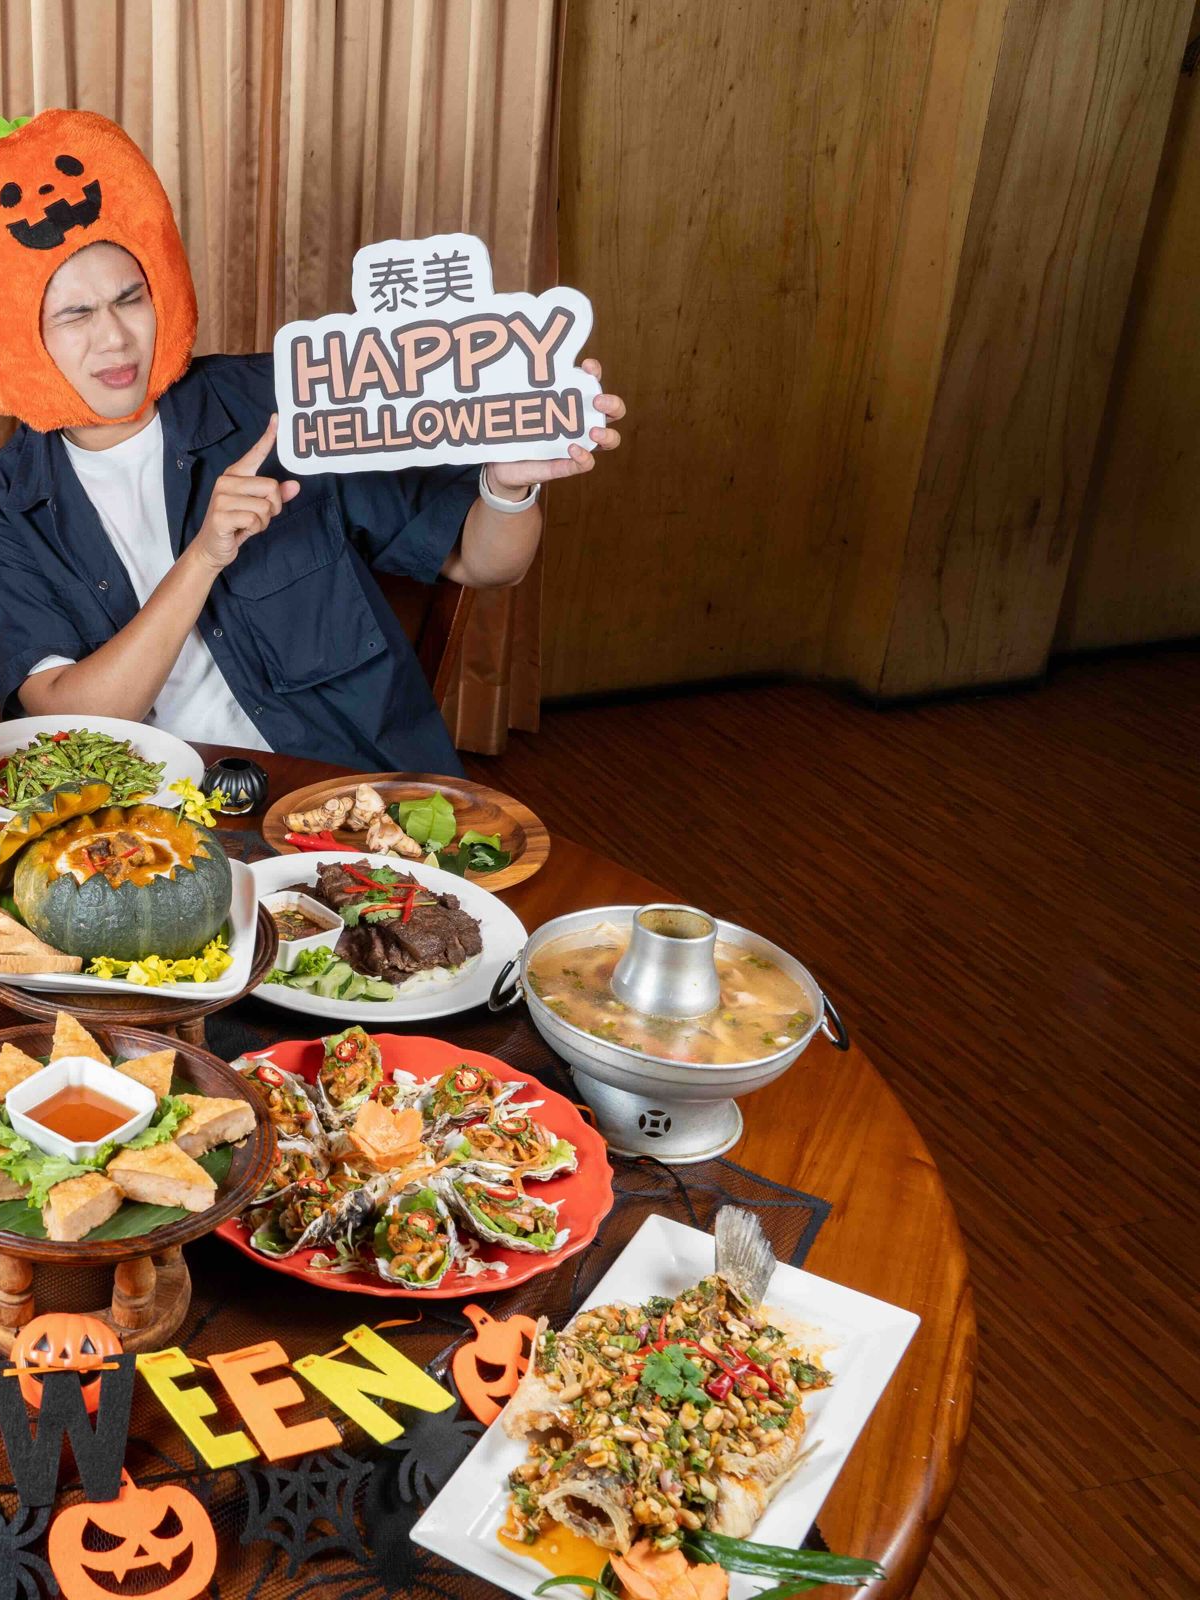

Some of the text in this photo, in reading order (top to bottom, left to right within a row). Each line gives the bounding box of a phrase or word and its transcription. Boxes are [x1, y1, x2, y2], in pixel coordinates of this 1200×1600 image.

[369, 249, 475, 313] 泰美
[291, 306, 576, 408] HAPPY
[292, 387, 585, 458] HELLOWEEN
